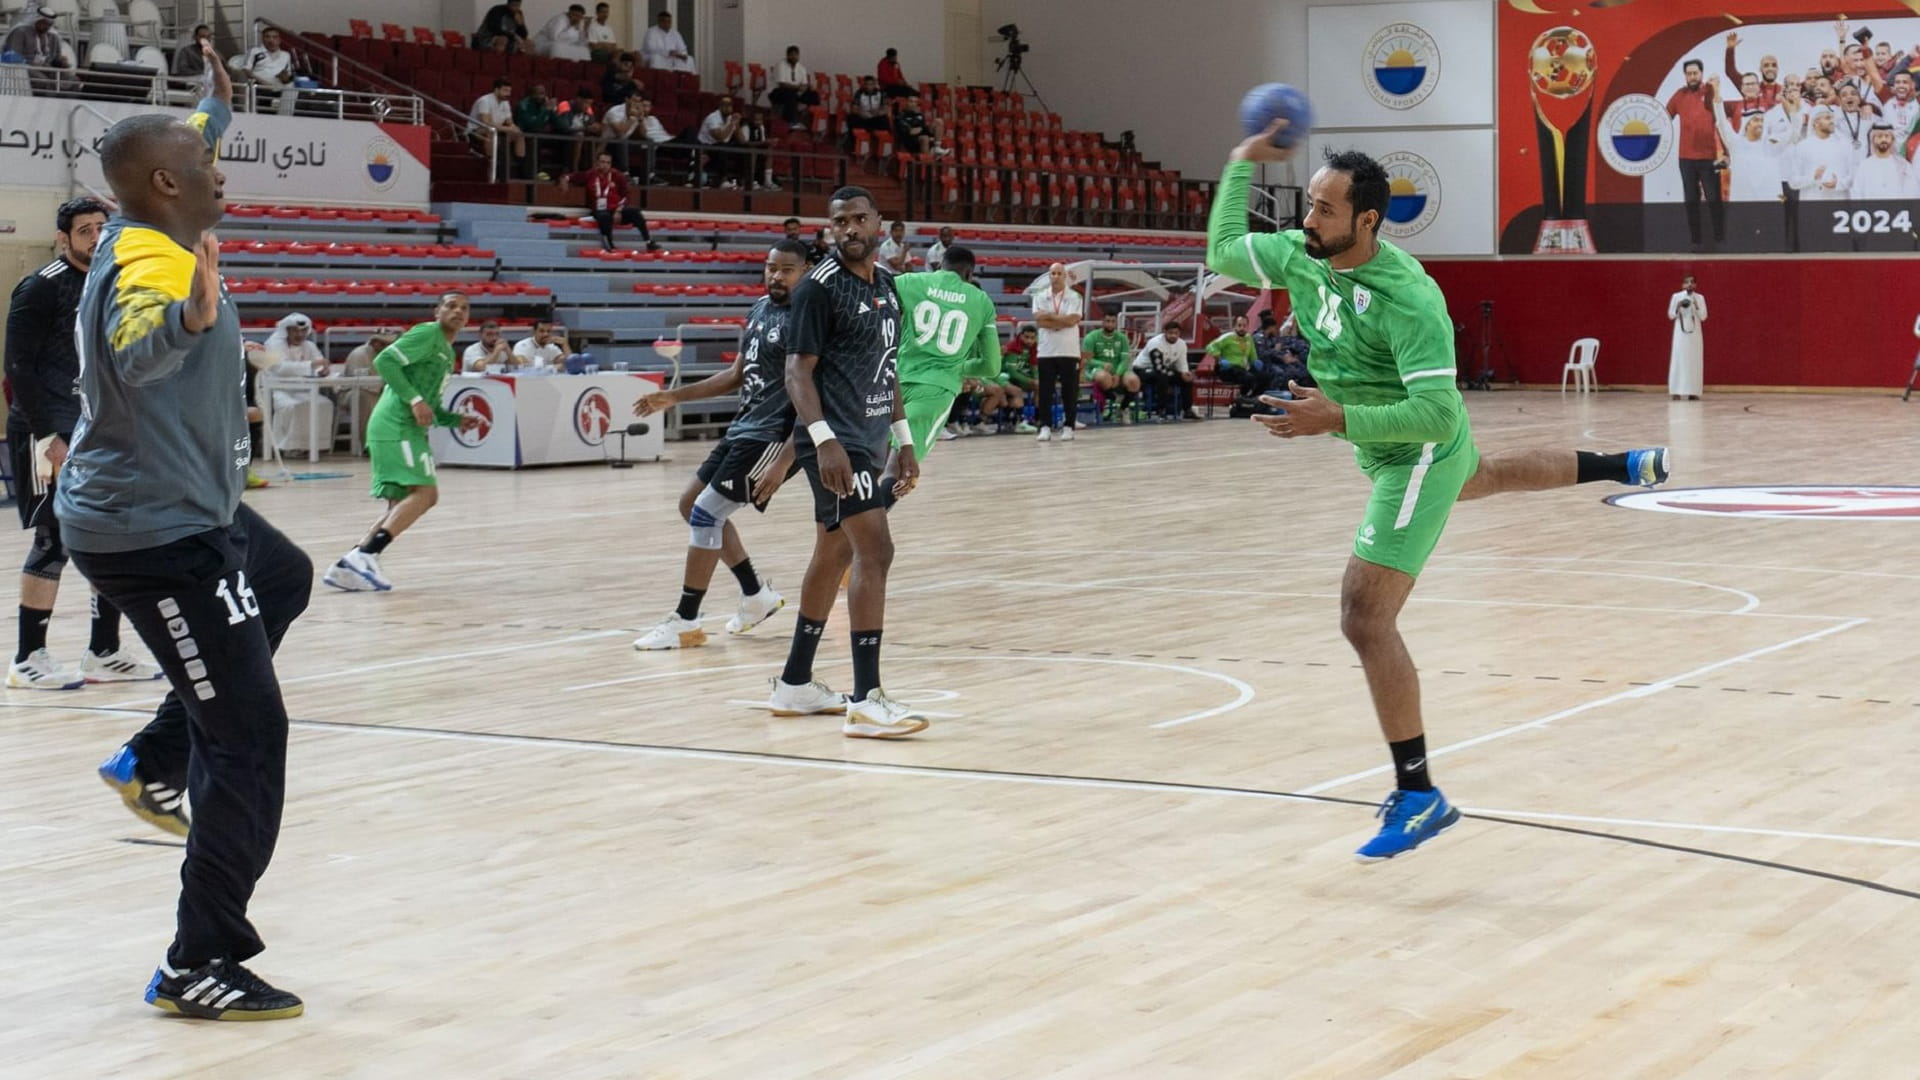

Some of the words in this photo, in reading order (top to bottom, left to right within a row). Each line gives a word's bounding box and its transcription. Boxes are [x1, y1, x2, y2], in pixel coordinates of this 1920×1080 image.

[273, 141, 326, 178] نادي
[1832, 210, 1913, 233] 2024
[927, 287, 967, 304] MANDO
[913, 300, 969, 355] 90
[1315, 285, 1343, 341] 14
[881, 318, 895, 348] 19
[853, 470, 873, 501] 19
[215, 570, 260, 625] 16
